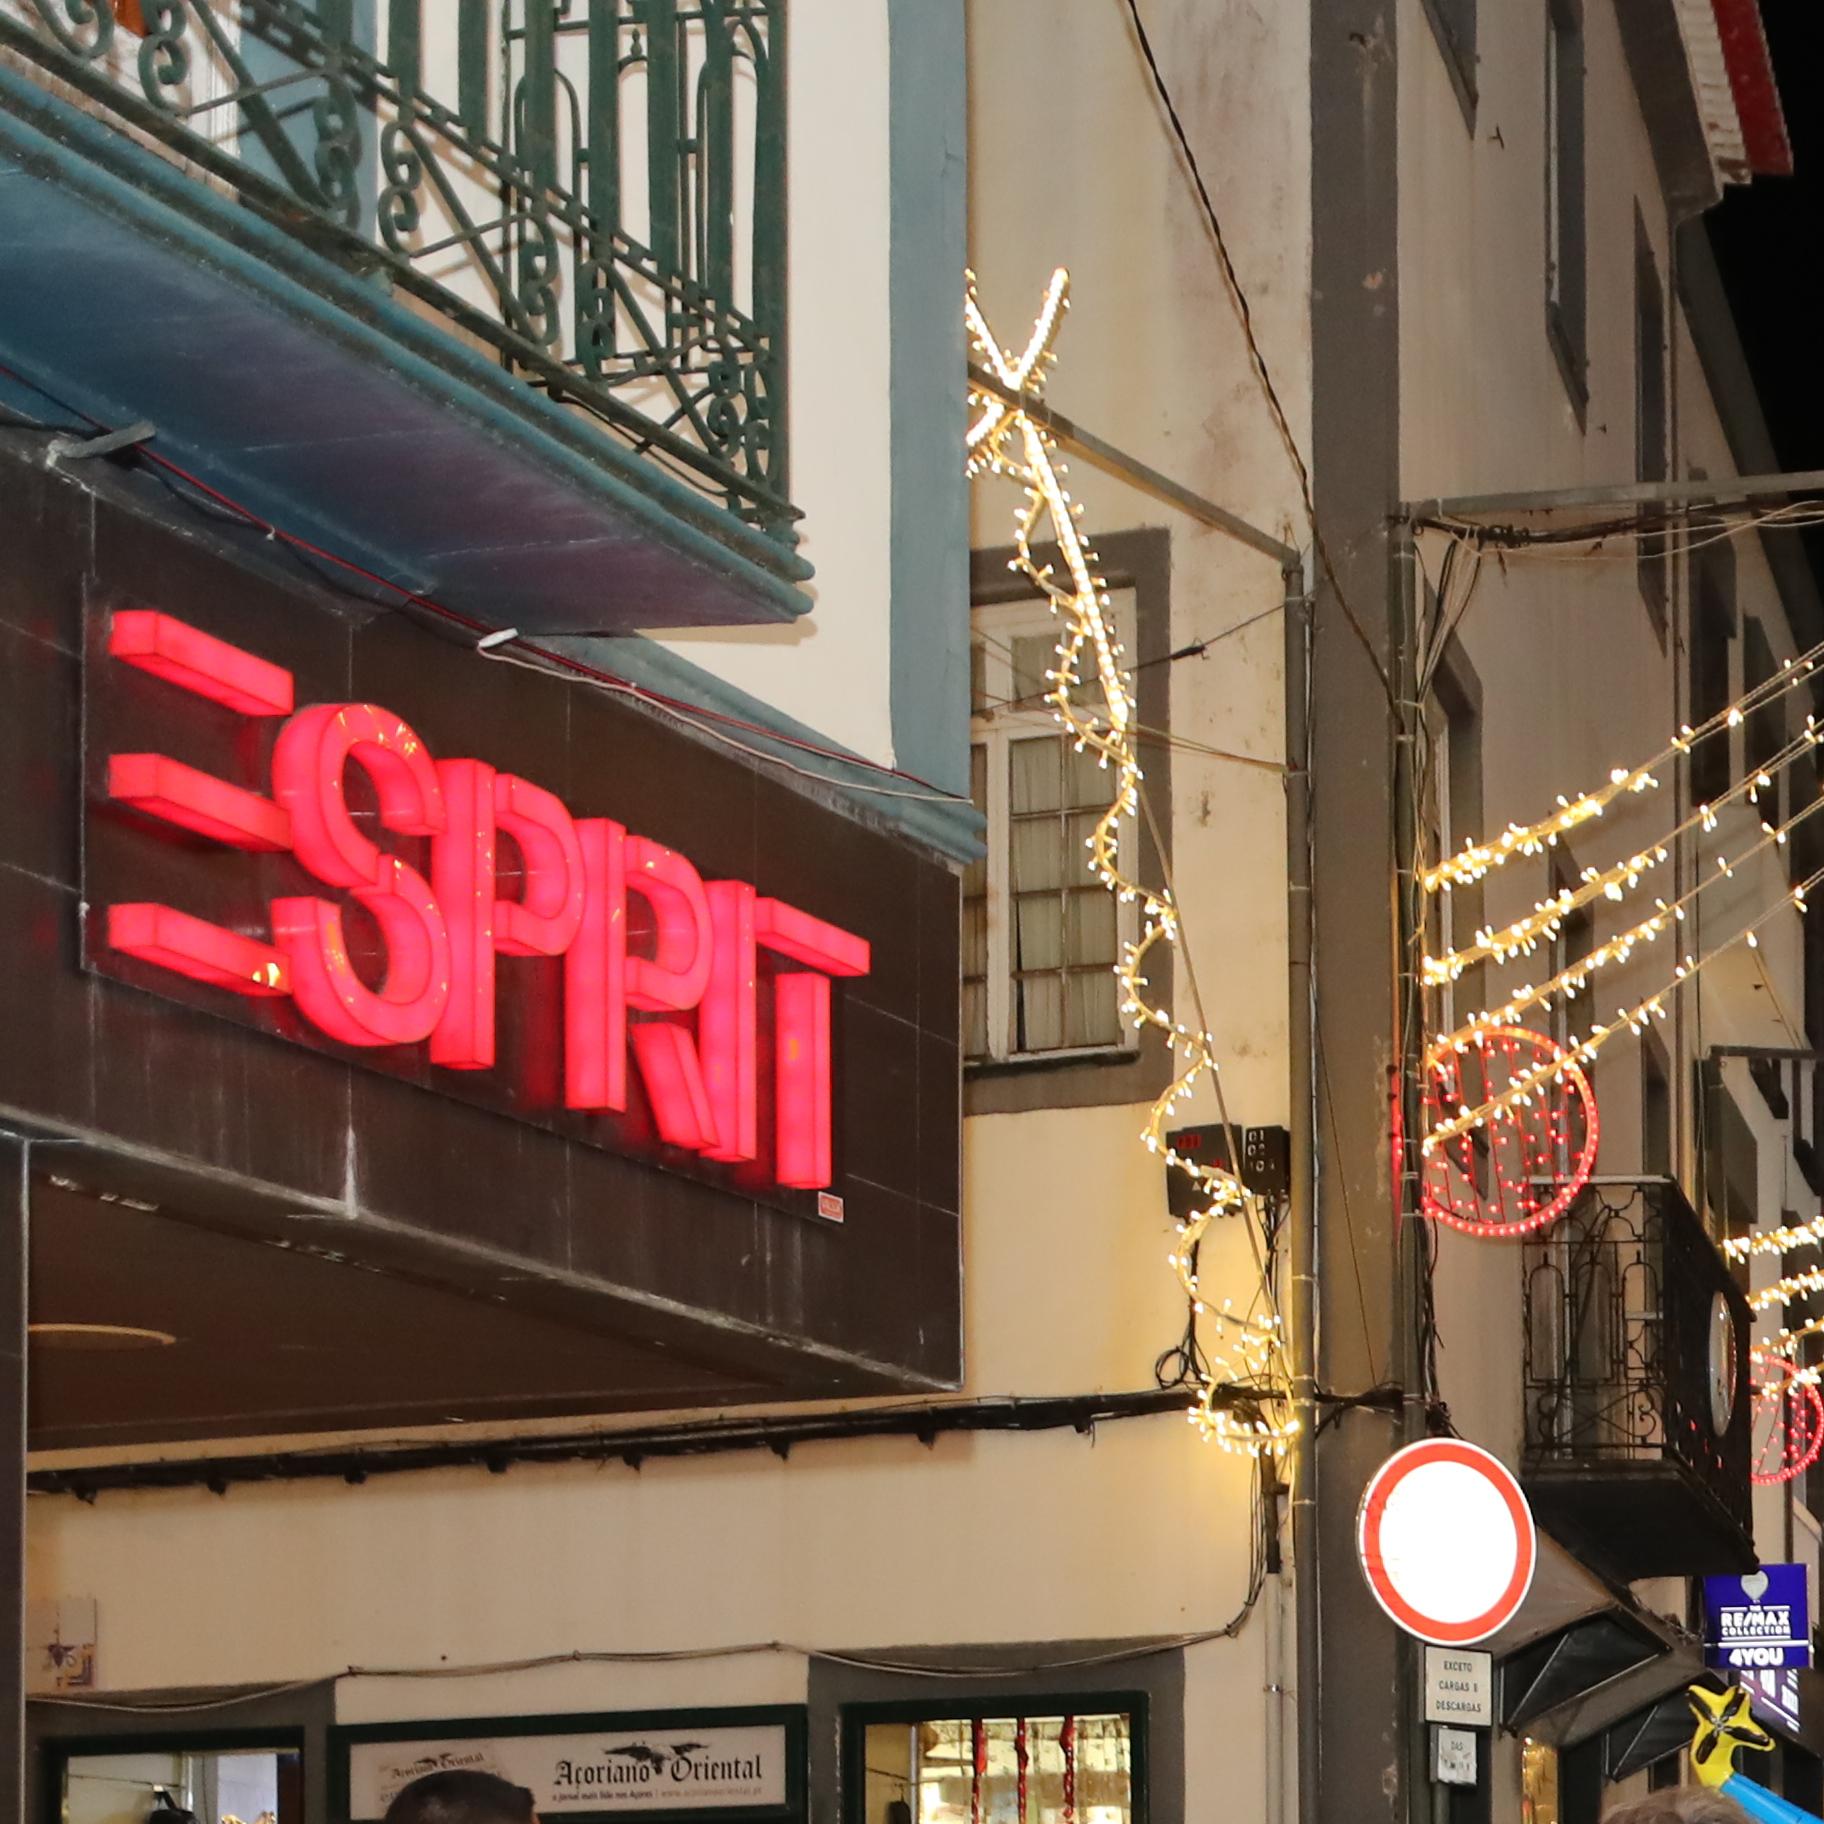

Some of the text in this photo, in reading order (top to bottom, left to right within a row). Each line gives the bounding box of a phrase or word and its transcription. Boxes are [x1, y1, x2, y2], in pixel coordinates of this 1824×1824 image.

[109, 610, 870, 1189] ESPRIT
[1721, 1611, 1790, 1627] RE/MAX
[1722, 1626, 1791, 1636] COLLECTION
[1729, 1648, 1784, 1666] 4YOU
[1443, 1660, 1473, 1672] EXCETO
[1438, 1680, 1470, 1692] CARGAS
[1435, 1700, 1482, 1713] DESCARGAS
[554, 1754, 763, 1789] Açoriano Oriental
